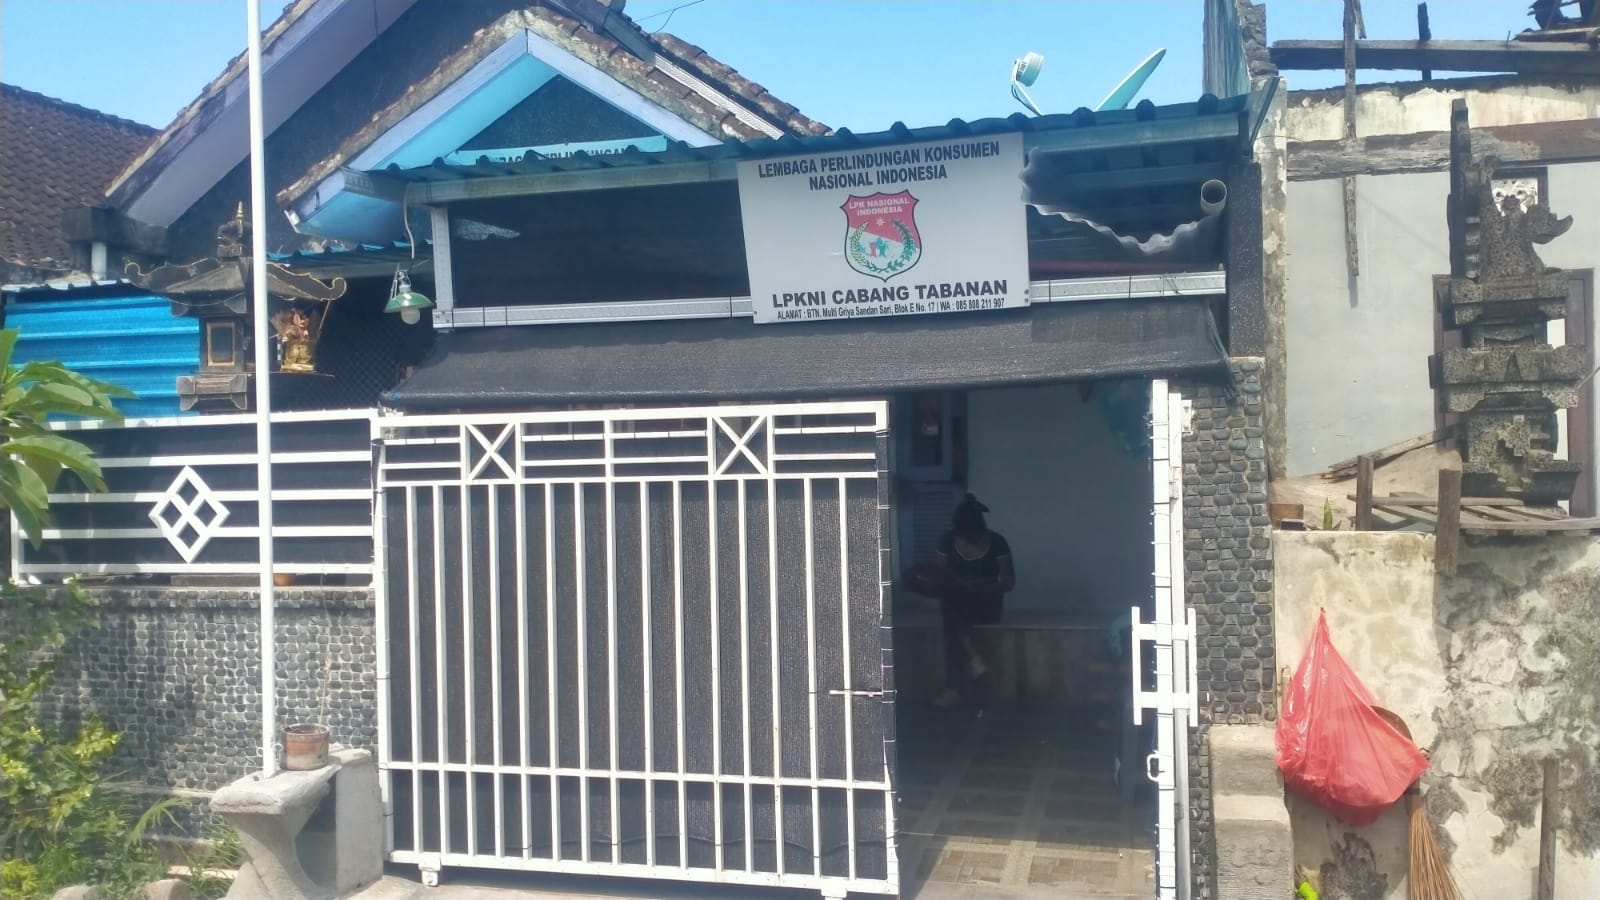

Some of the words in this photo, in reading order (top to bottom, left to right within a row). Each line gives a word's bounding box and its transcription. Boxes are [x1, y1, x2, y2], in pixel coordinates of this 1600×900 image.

[758, 160, 817, 178] LEMBAGA
[821, 149, 920, 171] PERLINDUNGAN
[924, 141, 1000, 162] KONSUMEN
[809, 172, 873, 191] NASIONAL
[876, 164, 947, 185] INDONESIA
[849, 201, 865, 209] LPK
[867, 197, 910, 207] NASIONAL
[857, 206, 903, 216] INDONESIA
[772, 291, 826, 308] LPKNI
[832, 286, 910, 304] CABANG
[915, 280, 1007, 299] TABANAN
[777, 309, 802, 320] ALAMAT
[807, 308, 822, 318] BTN.
[822, 306, 838, 317] Multi
[839, 306, 855, 319] Griya
[855, 305, 878, 316] Sandan
[879, 304, 894, 316] Sari,
[894, 302, 909, 314] Blok
[909, 302, 915, 313] E
[915, 302, 927, 313] No.
[928, 301, 935, 312] 17
[940, 300, 951, 311] WA
[956, 300, 968, 310] 085
[981, 298, 993, 309] 211
[993, 297, 1005, 308] 907
